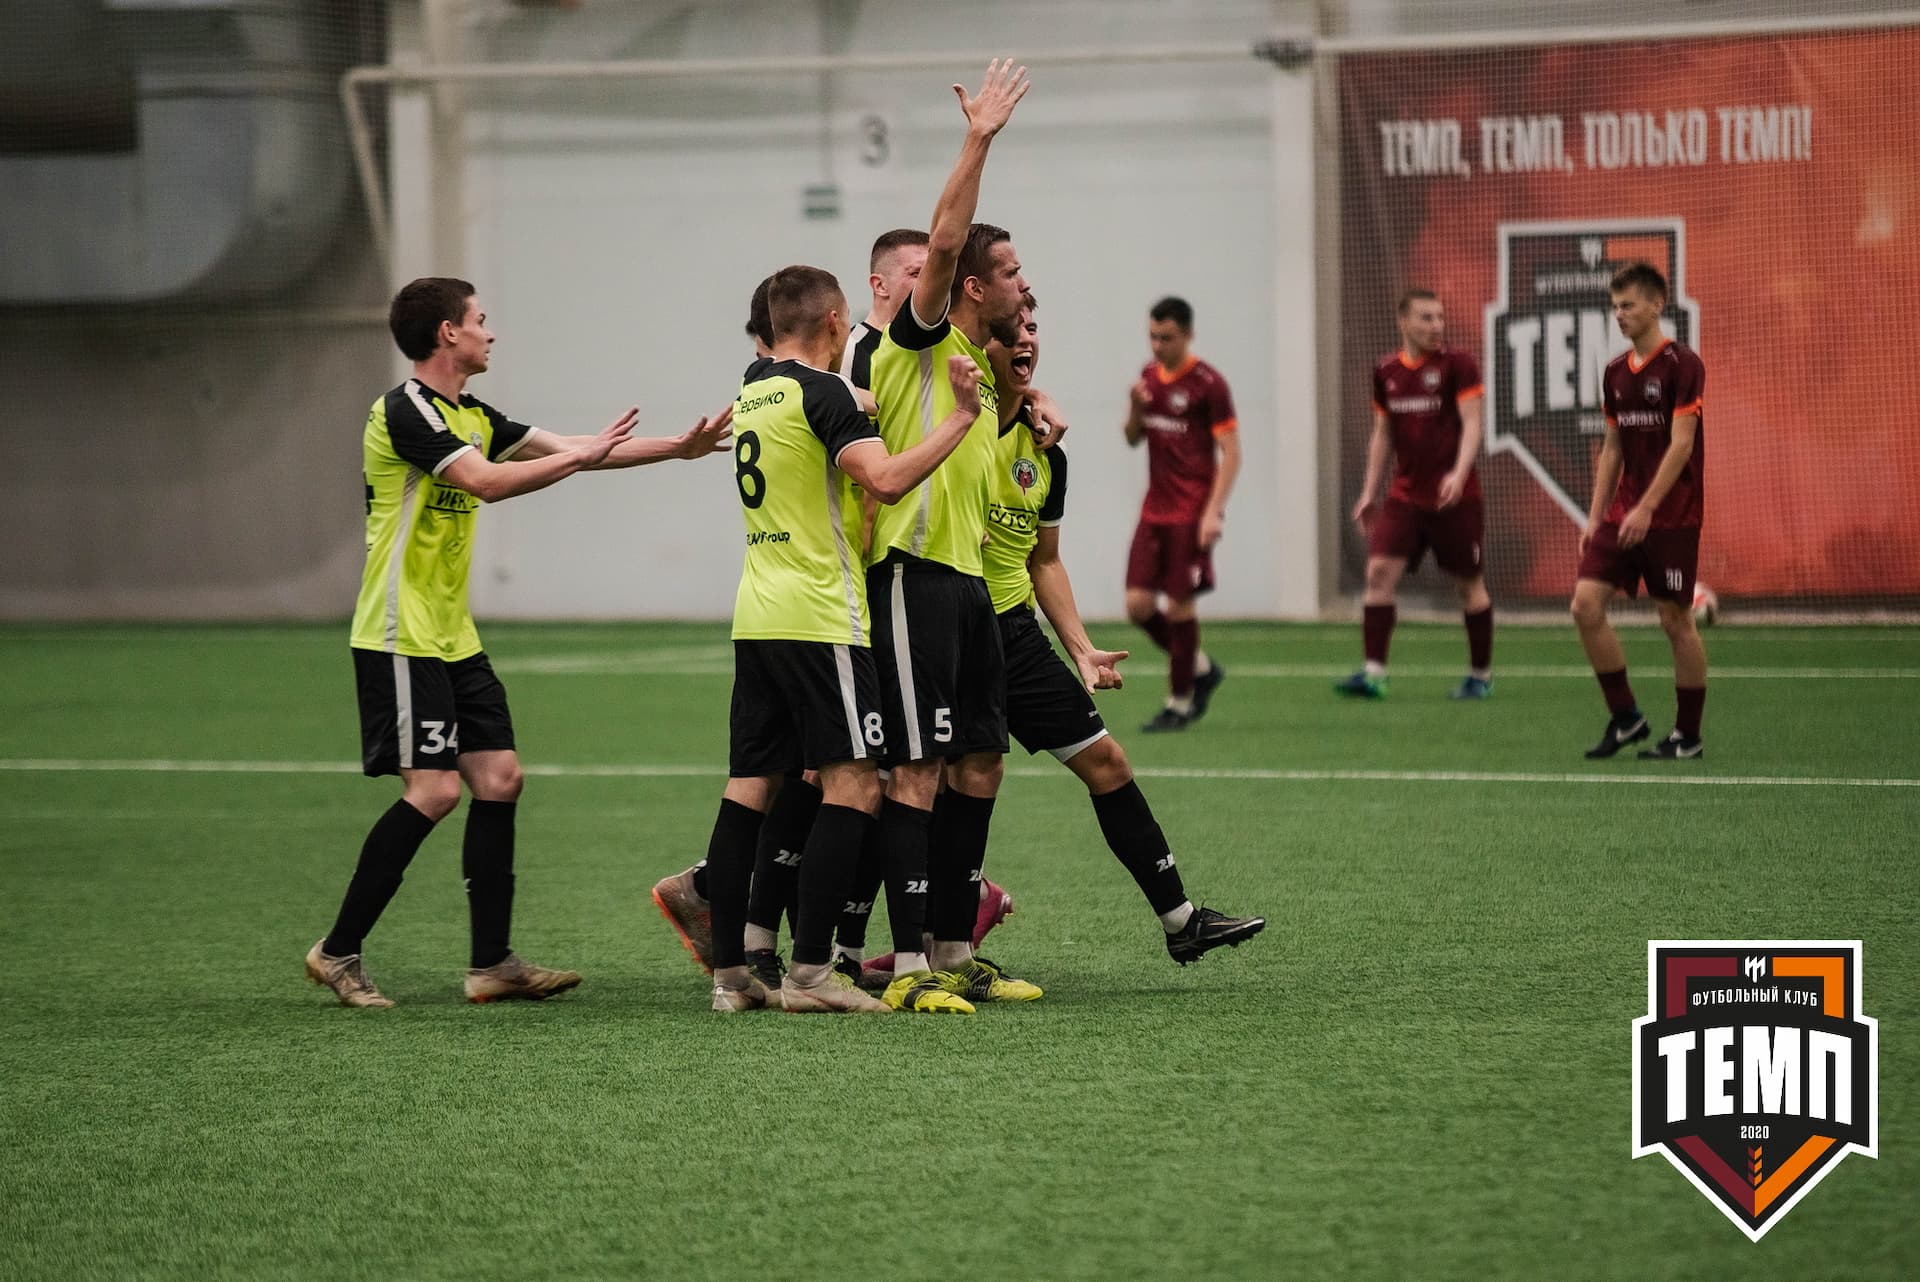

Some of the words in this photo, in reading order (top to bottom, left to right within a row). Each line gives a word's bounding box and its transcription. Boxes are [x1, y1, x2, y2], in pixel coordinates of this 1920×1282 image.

[861, 114, 890, 168] 3
[1381, 118, 1471, 181] ТЕМП,
[1479, 113, 1574, 176] ТЕМП,
[1584, 108, 1707, 170] ТОЛЬКО
[1716, 103, 1813, 164] ТЕМП!
[735, 430, 767, 510] 8
[419, 720, 459, 755] 34
[863, 711, 885, 747] 8
[934, 707, 953, 743] 5
